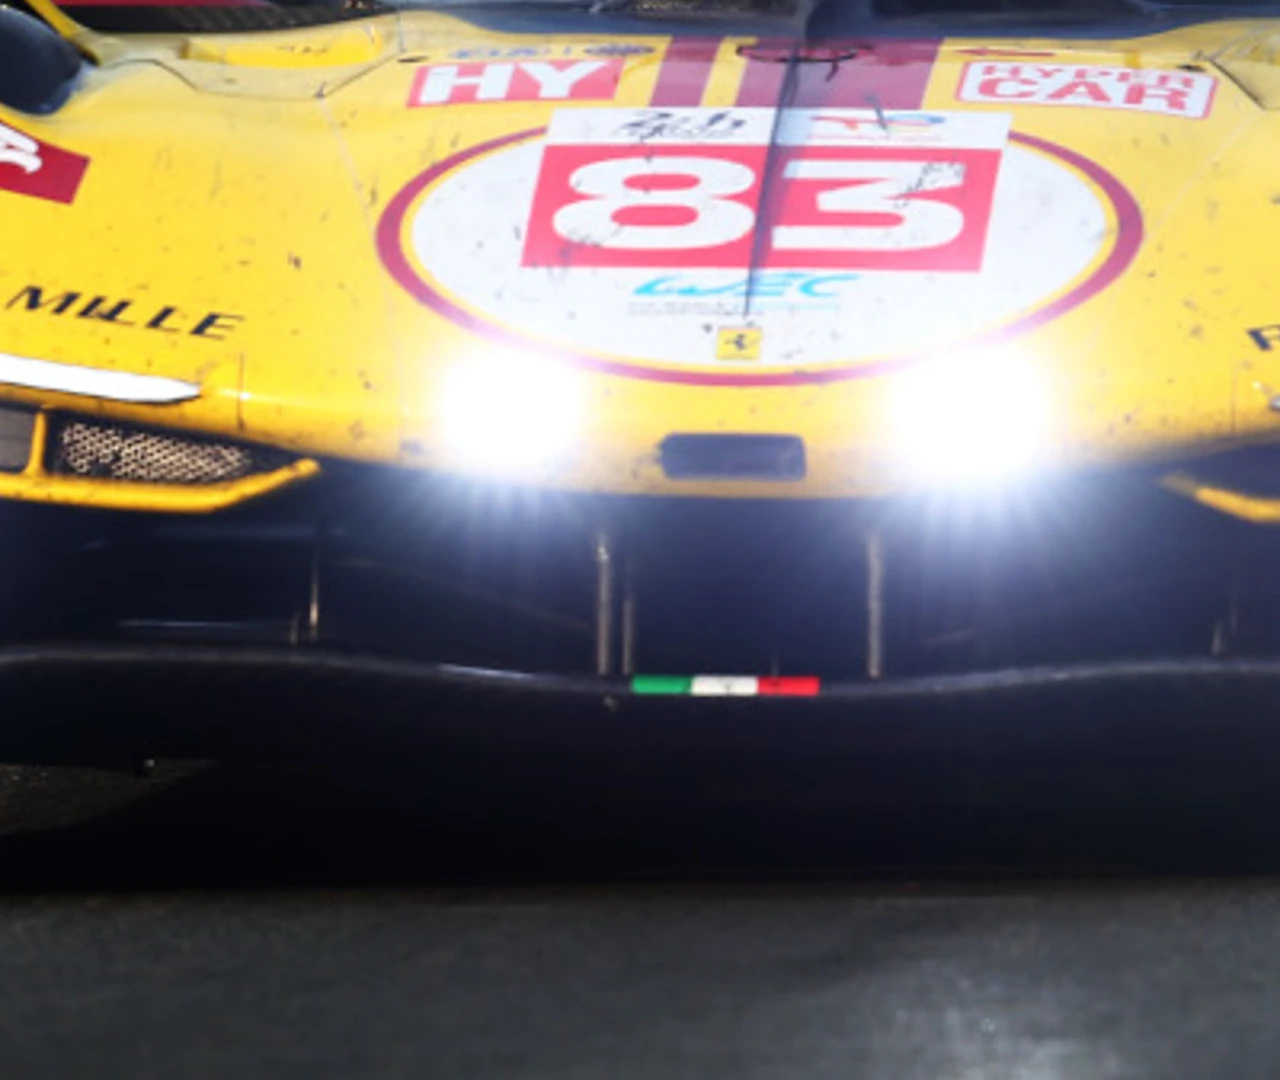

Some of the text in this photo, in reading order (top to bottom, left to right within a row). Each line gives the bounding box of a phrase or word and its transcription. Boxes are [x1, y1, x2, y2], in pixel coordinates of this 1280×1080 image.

[419, 60, 612, 104] HY
[977, 76, 1190, 111] CAR
[551, 154, 966, 251] 83
[4, 284, 246, 341] MILLE
